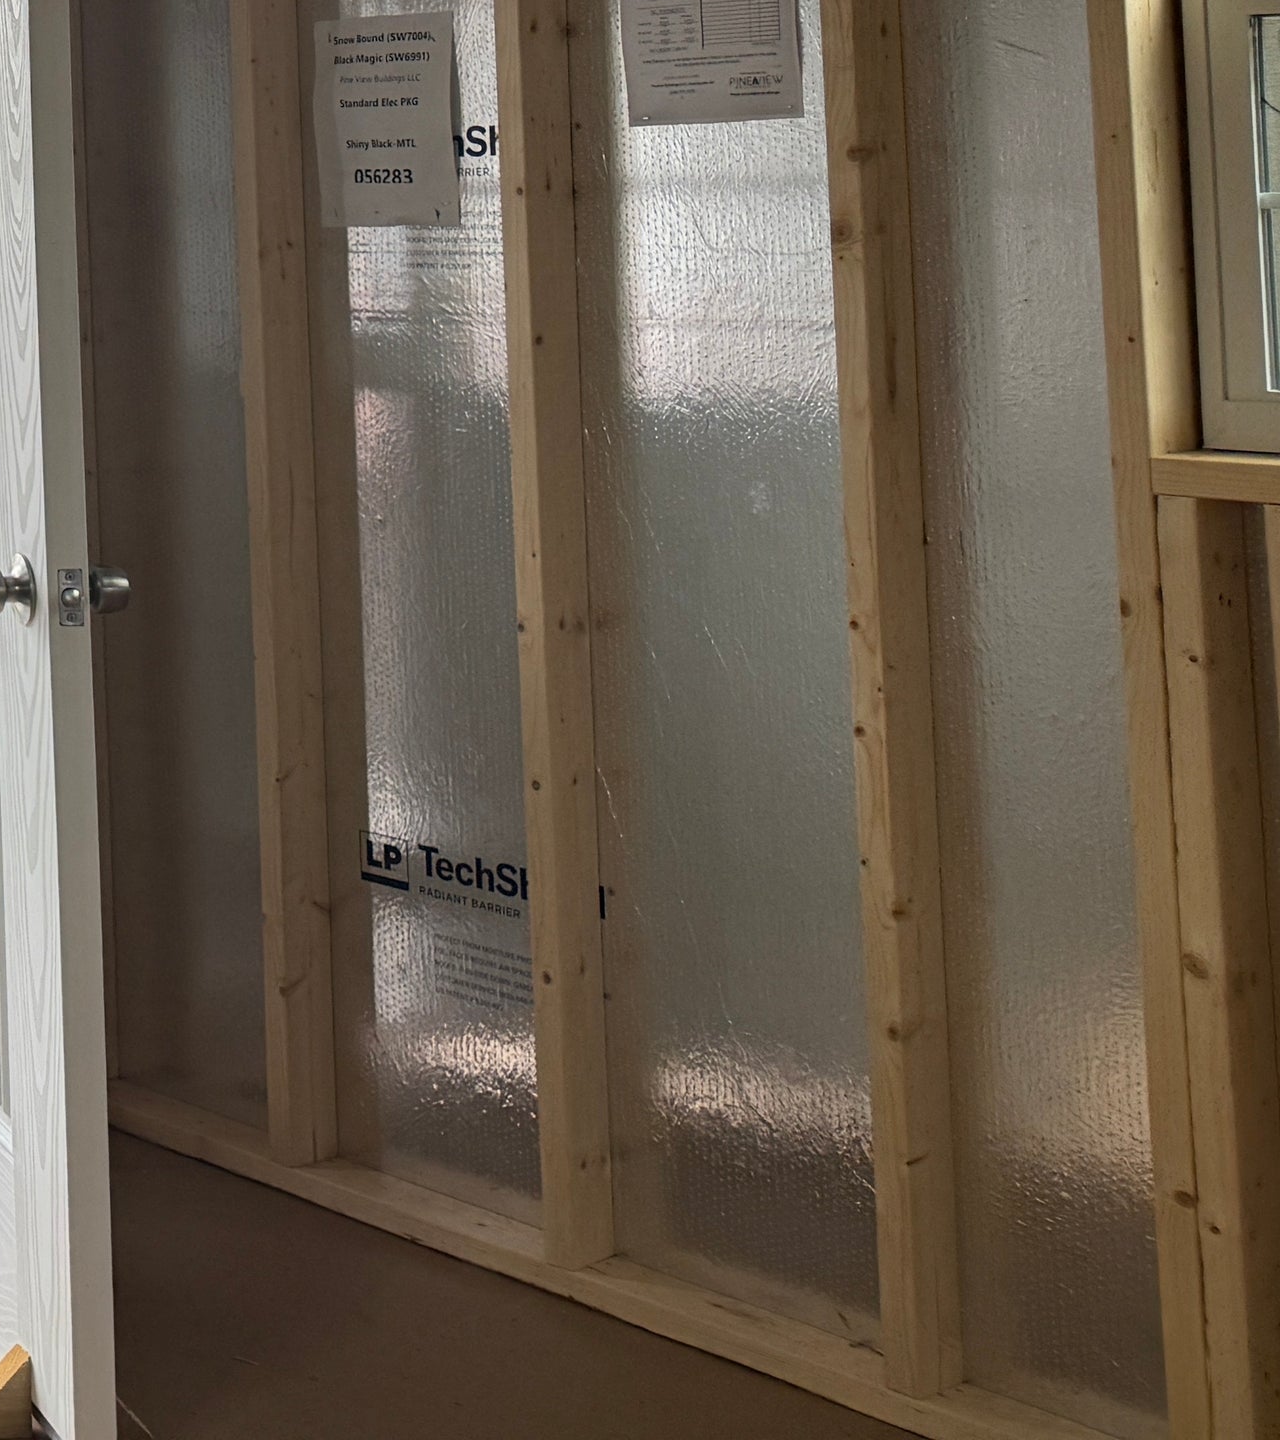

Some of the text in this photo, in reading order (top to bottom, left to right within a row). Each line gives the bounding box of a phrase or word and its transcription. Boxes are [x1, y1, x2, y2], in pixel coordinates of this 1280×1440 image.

[333, 35, 355, 46] Snow
[356, 33, 384, 43] Bound
[333, 52, 430, 66] Black Magic (SW6991)
[374, 74, 406, 85] Buildings
[407, 73, 422, 82] LLC
[339, 97, 419, 109] Standard Elec PKG
[345, 139, 369, 151] Shiny
[354, 168, 414, 184] 056283
[457, 166, 491, 178] RRIER
[366, 838, 529, 901] LP TechSh
[418, 885, 522, 920] RADIANT BARRIER
